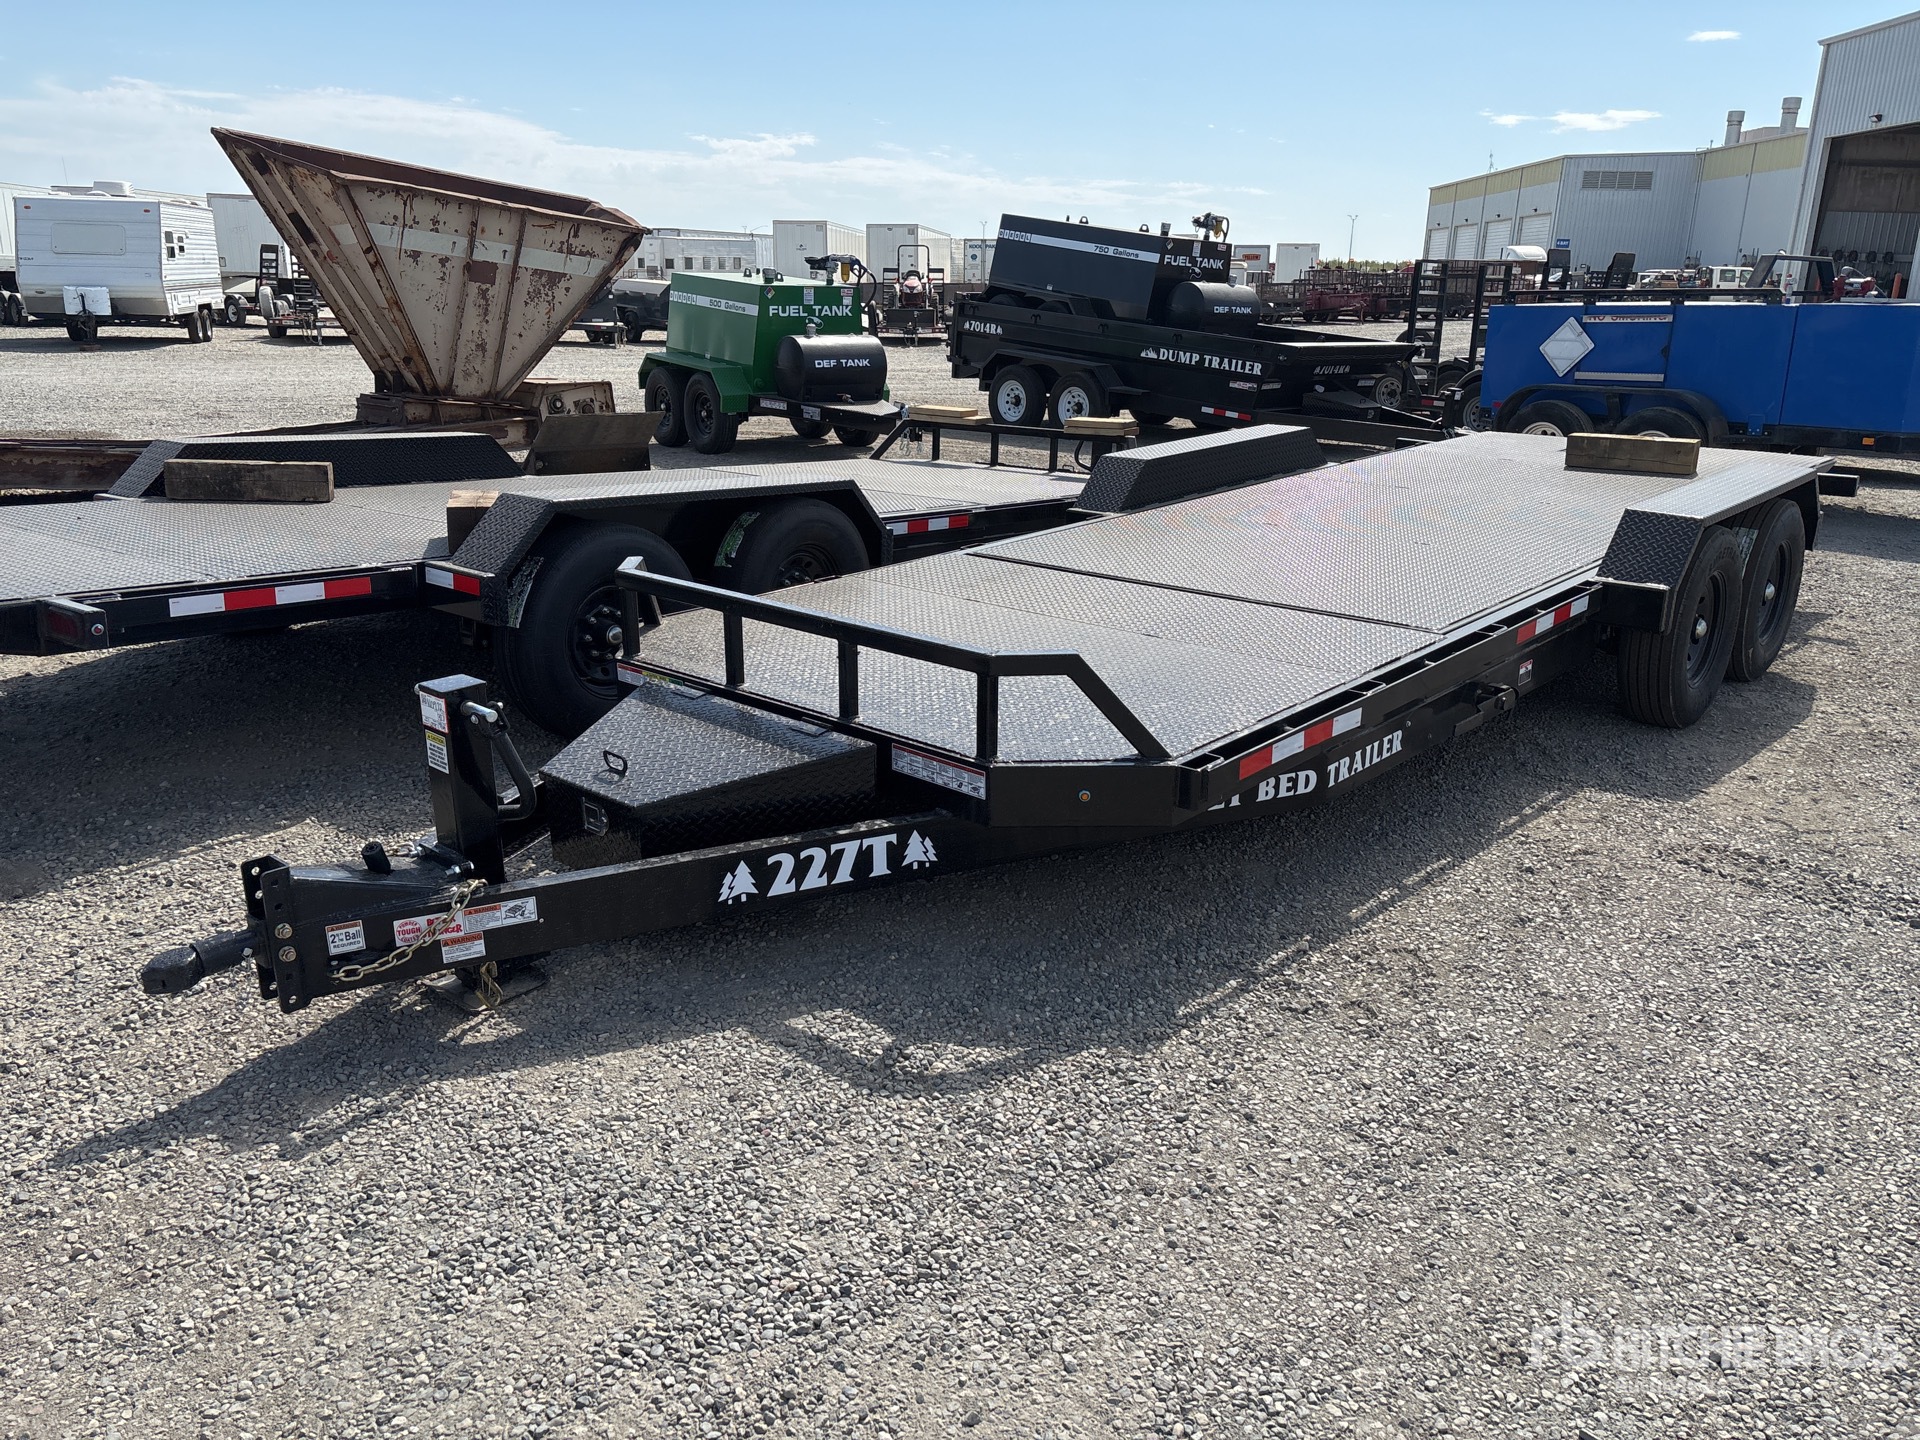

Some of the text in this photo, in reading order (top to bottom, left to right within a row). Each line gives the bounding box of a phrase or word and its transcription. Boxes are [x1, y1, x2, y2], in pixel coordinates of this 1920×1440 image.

[1094, 245, 1140, 258] 750 Gallons
[1164, 254, 1224, 270] FUEL TANK
[709, 299, 746, 313] 500 Gallons
[769, 305, 853, 317] FUEL TANK
[1213, 306, 1252, 314] DEF TANK
[969, 320, 998, 335] 7014R
[814, 358, 871, 368] DEF TANK
[1158, 347, 1262, 376] DUMP TRAILER
[1255, 729, 1403, 803] BED TRAILER
[766, 833, 897, 897] 227T
[344, 929, 361, 941] Ball
[396, 926, 421, 937] TOUGH
